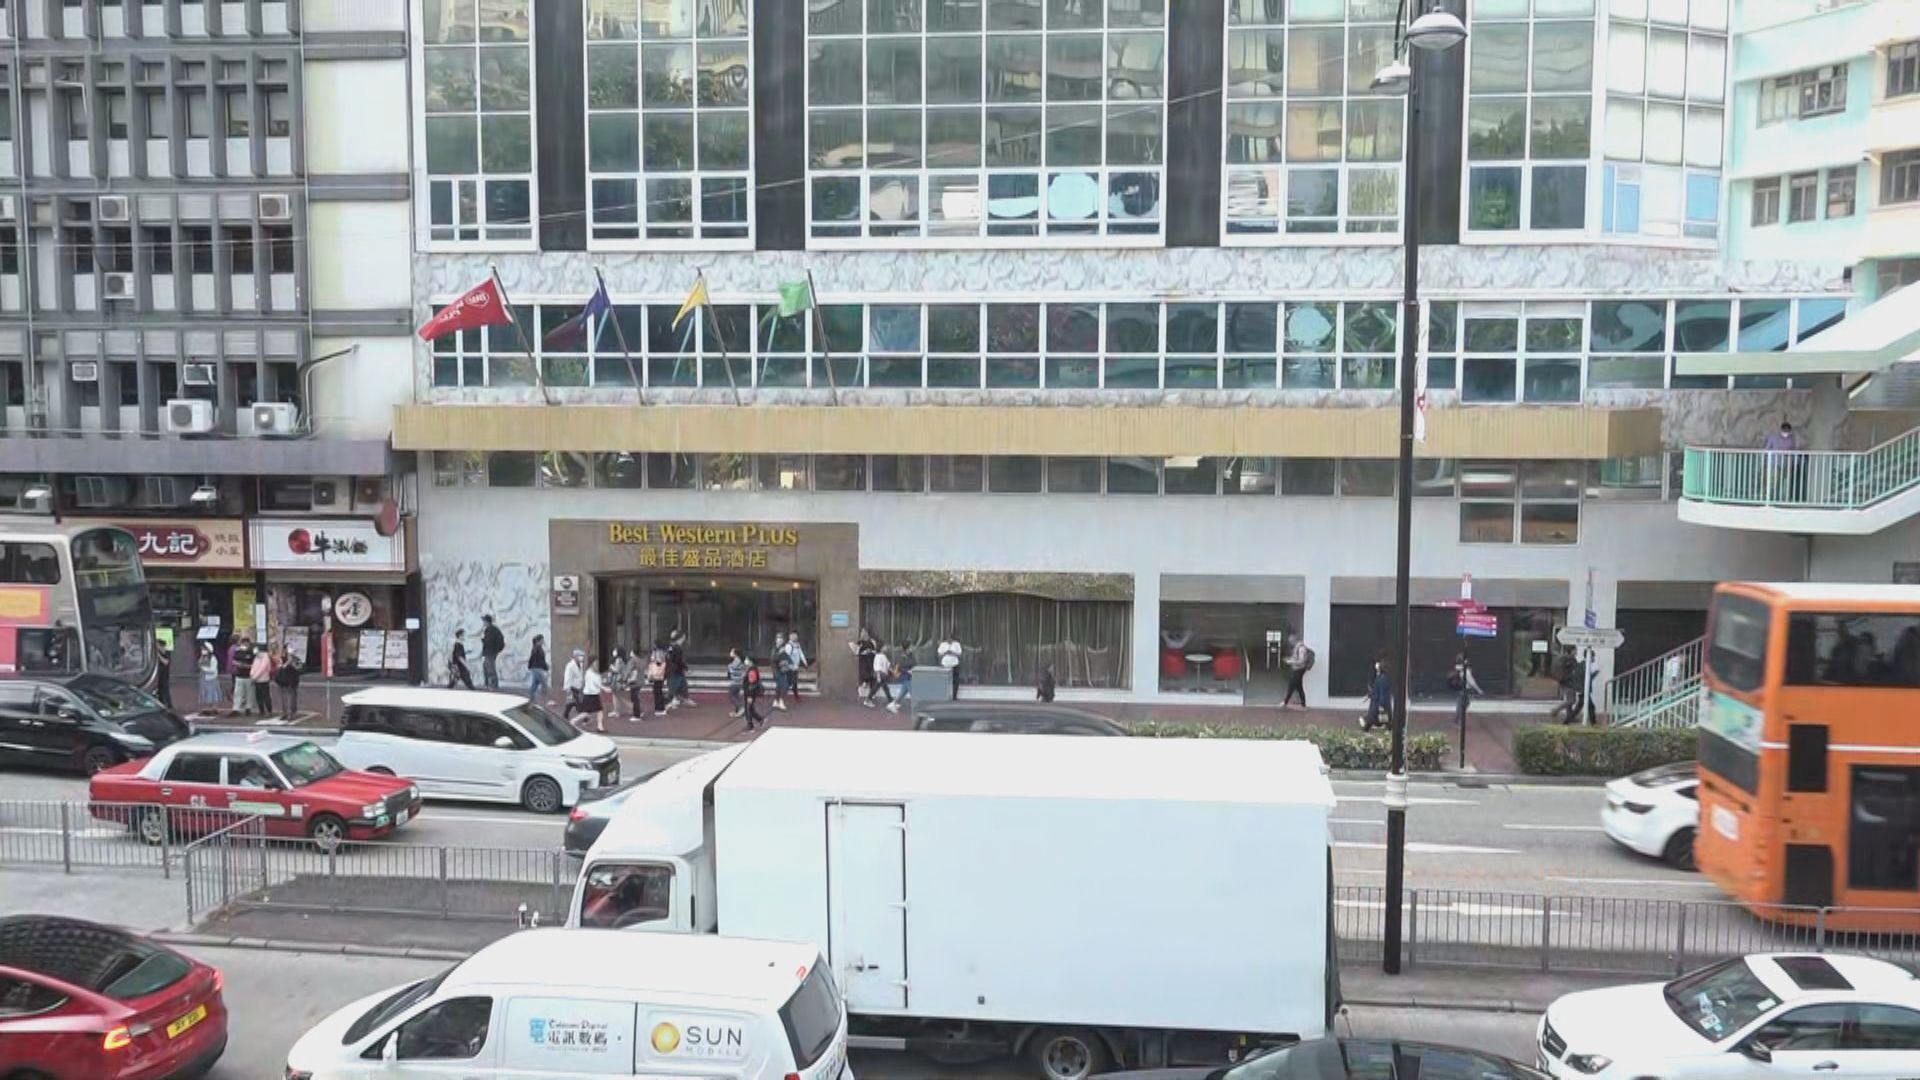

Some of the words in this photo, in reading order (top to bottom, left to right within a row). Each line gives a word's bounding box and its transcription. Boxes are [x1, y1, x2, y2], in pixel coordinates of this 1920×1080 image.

[138, 532, 198, 555] 九記
[609, 523, 649, 543] Best
[659, 524, 736, 544] Western
[639, 548, 768, 568] 最佳盛品酒店
[548, 1030, 608, 1045] 電訊數碼
[686, 1026, 742, 1046] SUN
[686, 1046, 740, 1056] MOBILE
